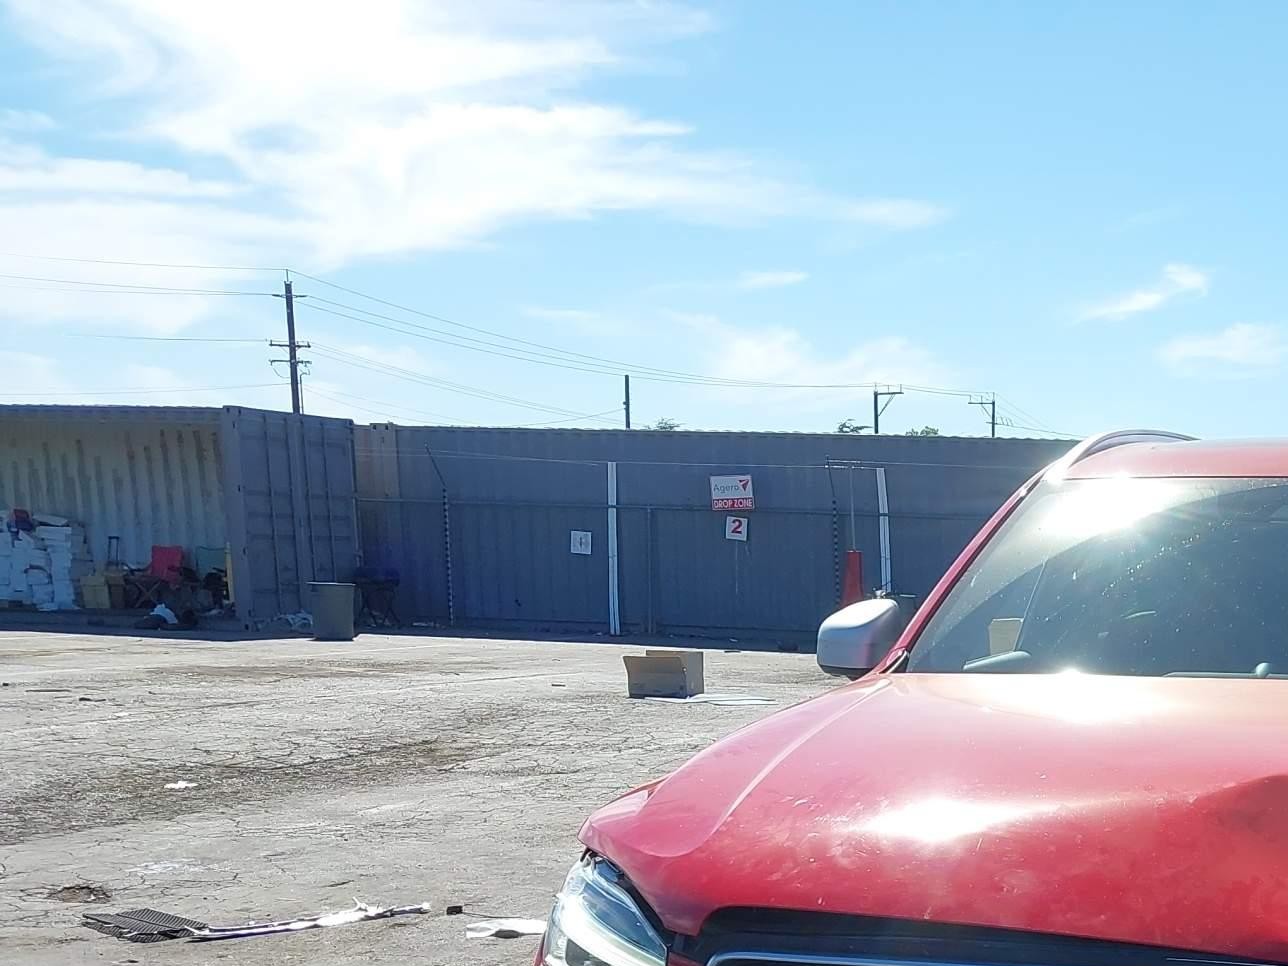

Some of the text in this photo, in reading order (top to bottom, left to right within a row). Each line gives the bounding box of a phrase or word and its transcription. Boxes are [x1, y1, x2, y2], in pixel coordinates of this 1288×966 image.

[713, 499, 753, 509] DROP ZONE
[731, 519, 743, 534] 2
